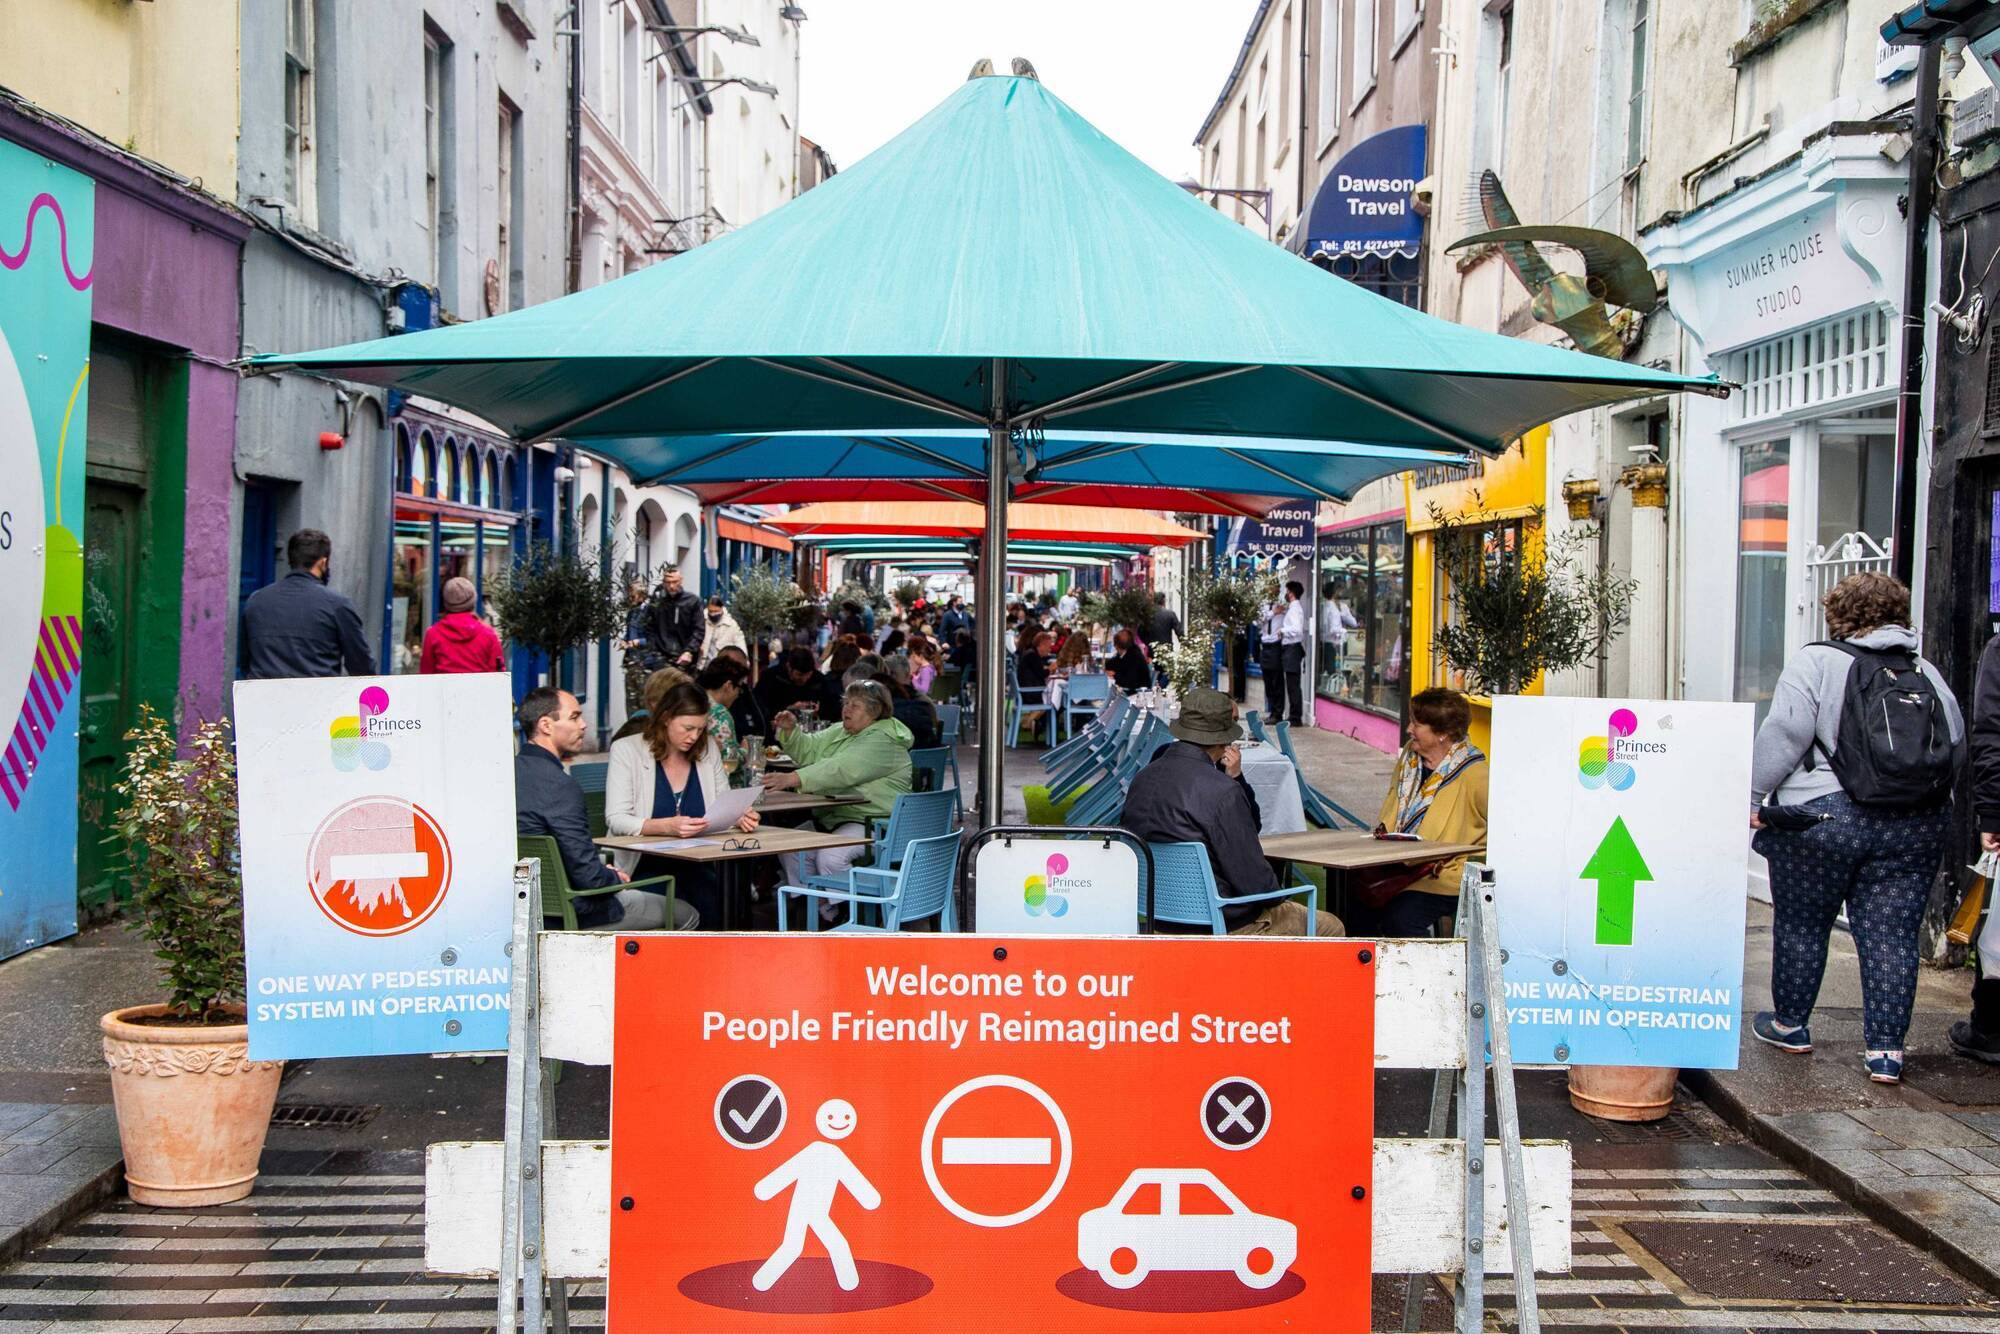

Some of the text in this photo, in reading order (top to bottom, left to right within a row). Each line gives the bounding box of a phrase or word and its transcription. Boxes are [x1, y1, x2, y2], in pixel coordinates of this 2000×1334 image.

[1338, 175, 1414, 192] Dawson
[1347, 198, 1405, 215] Travel
[1320, 240, 1338, 251] Tel:
[1344, 240, 1361, 251] 021
[1726, 233, 1823, 289] SUMMER HOUSE
[1756, 285, 1801, 317] STUDIO
[1260, 523, 1303, 538] Travel
[1248, 543, 1262, 551] Tel:
[1265, 543, 1278, 551] 021
[369, 717, 422, 730] Princes
[1616, 739, 1667, 753] Princes
[1615, 752, 1638, 760] Street
[1053, 877, 1092, 888] Princes
[258, 967, 508, 995] ONE WAY PEDESTRIAN
[865, 965, 1134, 997] Welcome to our
[1546, 982, 1595, 1000] WAY
[1600, 984, 1730, 1006] PEDESTRIAN
[257, 992, 511, 1021] SYSTEM IN OPERATION
[1507, 1007, 1731, 1030] YSTEM IN OPERATION
[703, 1009, 1292, 1050] People Friendly Reimagined Street
